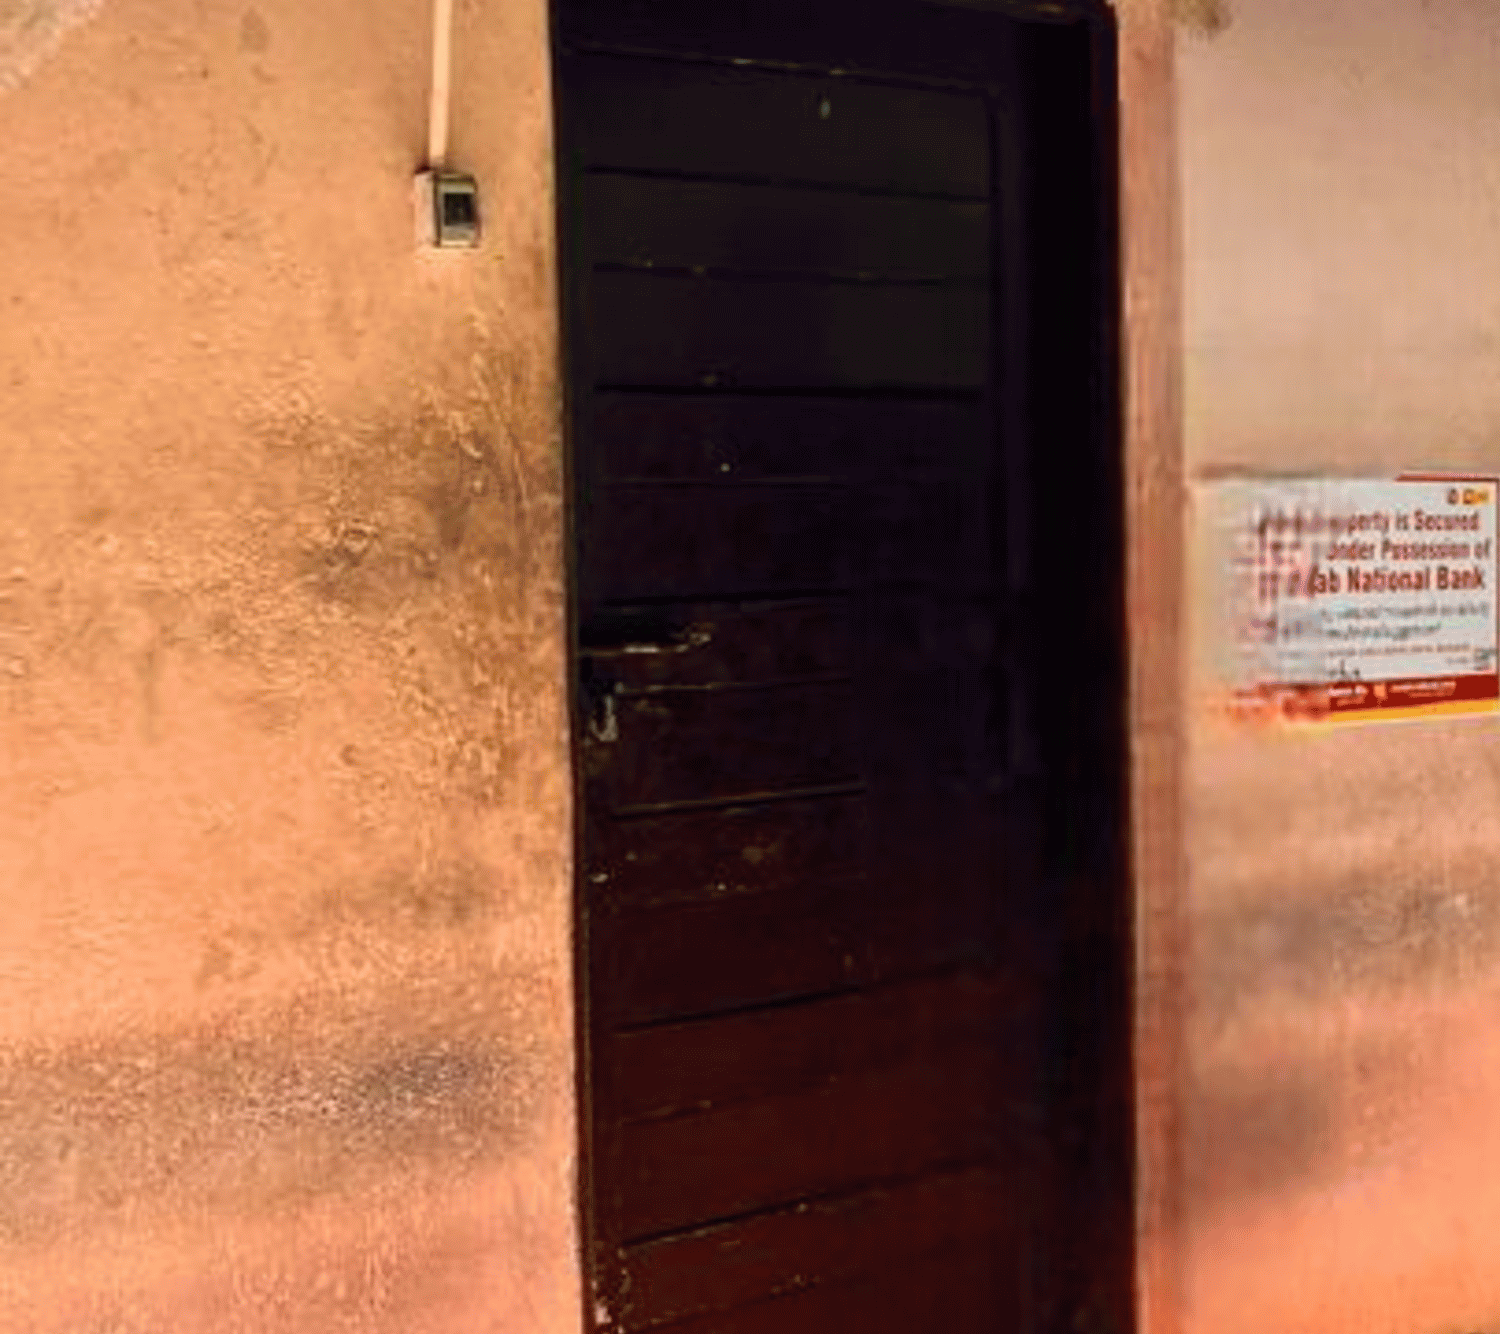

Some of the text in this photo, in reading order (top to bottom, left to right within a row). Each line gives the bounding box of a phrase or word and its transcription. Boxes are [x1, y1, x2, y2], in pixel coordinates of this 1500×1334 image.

[1382, 539, 1470, 560] Possession
[1348, 566, 1431, 593] National
[1437, 565, 1486, 590] Bank
